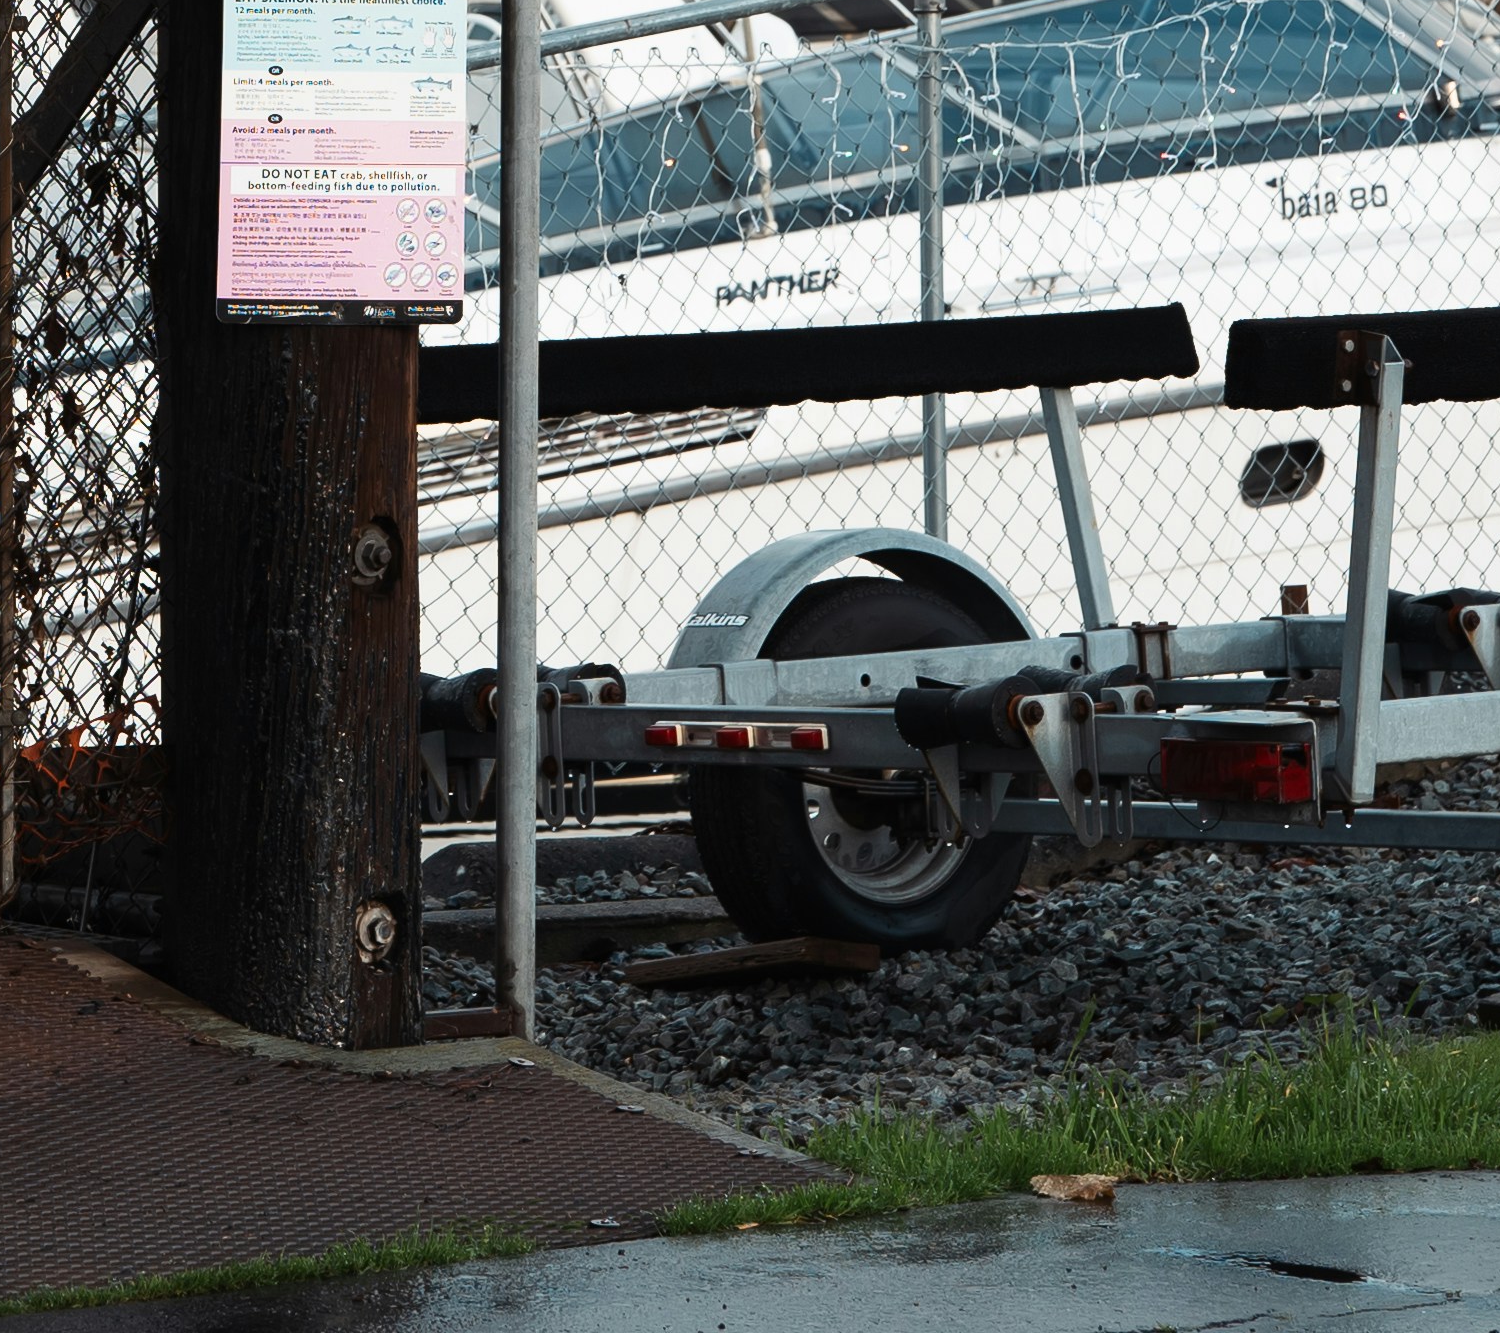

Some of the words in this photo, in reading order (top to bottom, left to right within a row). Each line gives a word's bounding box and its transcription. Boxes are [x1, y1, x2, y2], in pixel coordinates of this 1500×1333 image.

[287, 7, 316, 15] month.
[233, 78, 256, 86] Limit:
[308, 127, 337, 135] month.
[262, 169, 280, 179] DO
[285, 169, 309, 179] NOT
[314, 170, 337, 179] EAT
[340, 172, 366, 181] crab,
[369, 171, 413, 181] shellfish,
[248, 181, 331, 192] bottom-feeding
[334, 182, 352, 191] fish
[356, 182, 375, 191] due
[378, 183, 387, 191] to
[391, 183, 440, 193] pollution.
[1281, 176, 1338, 220] baia
[1350, 185, 1387, 210] 80
[716, 268, 839, 308] PANTHER
